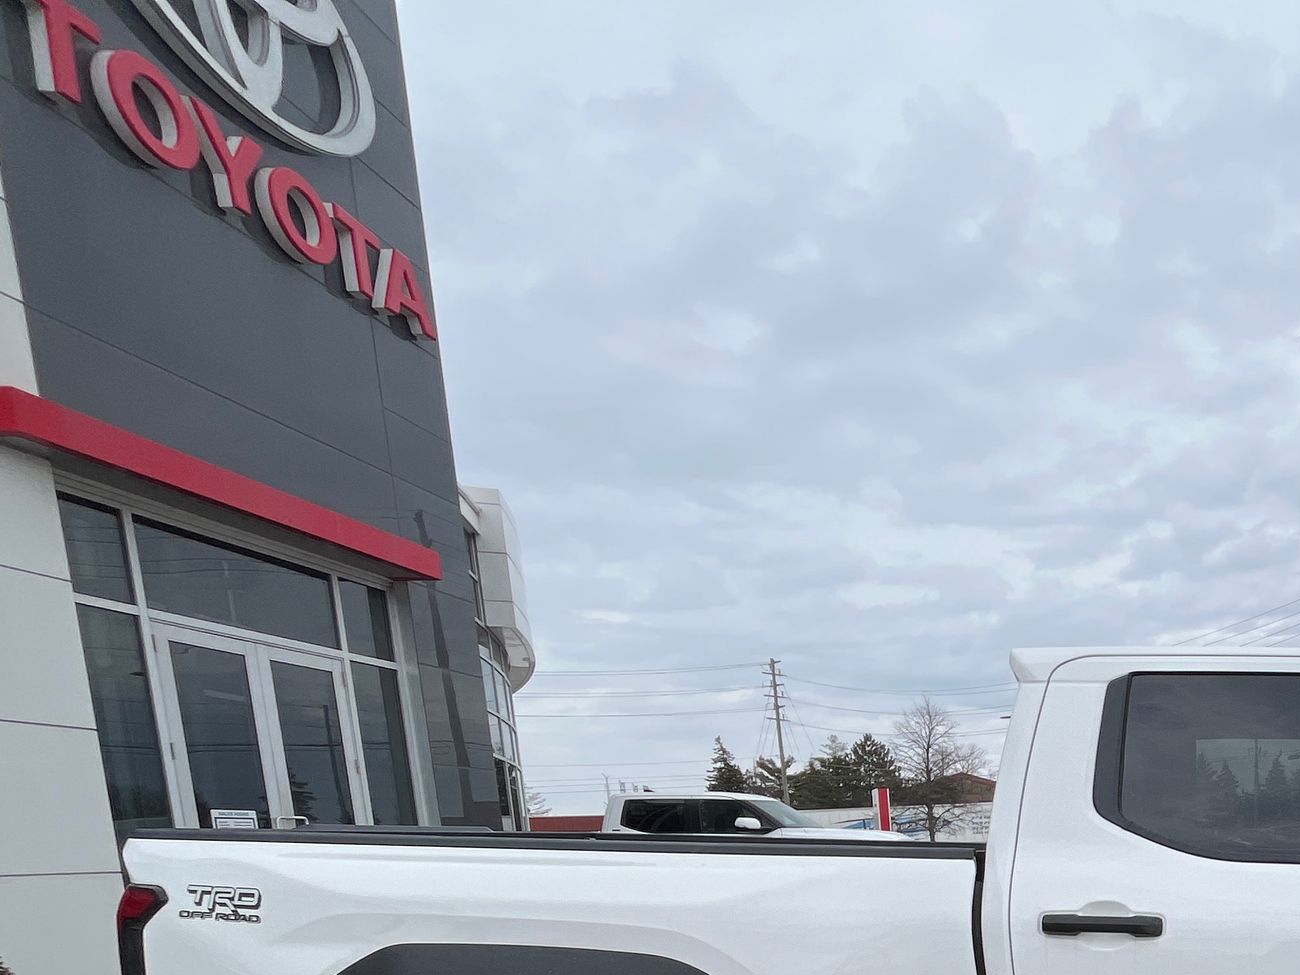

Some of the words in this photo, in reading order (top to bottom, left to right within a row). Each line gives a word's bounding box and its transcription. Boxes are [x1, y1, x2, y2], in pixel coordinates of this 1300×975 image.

[27, 0, 436, 341] TOYOTA
[187, 884, 262, 912] TRD
[179, 910, 212, 919] OFF
[215, 912, 261, 923] ROAD
